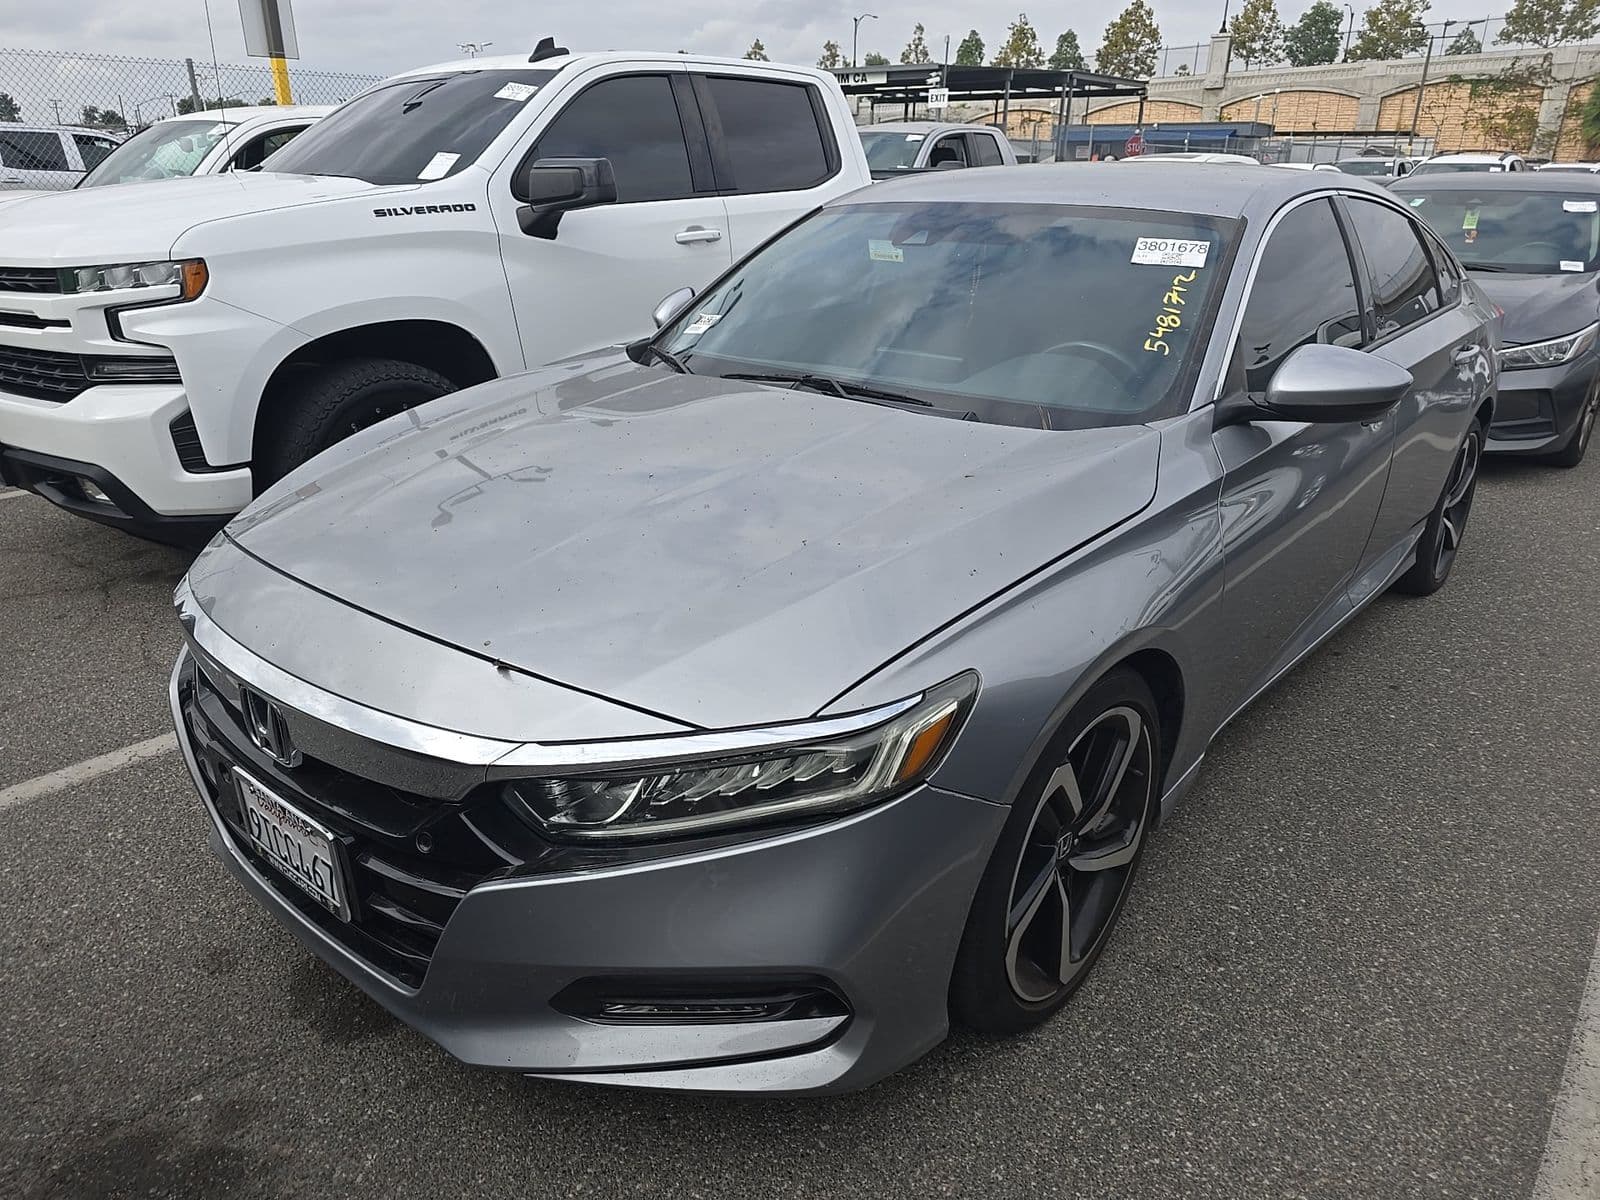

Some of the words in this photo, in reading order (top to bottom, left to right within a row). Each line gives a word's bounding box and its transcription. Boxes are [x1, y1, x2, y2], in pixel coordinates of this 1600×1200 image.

[834, 73, 850, 84] IM
[853, 73, 868, 83] CA
[930, 93, 946, 103] EXIT
[1127, 143, 1143, 153] STO
[373, 203, 476, 217] SILVERADO
[1138, 241, 1207, 254] 3801678
[1144, 269, 1196, 355] 5481712
